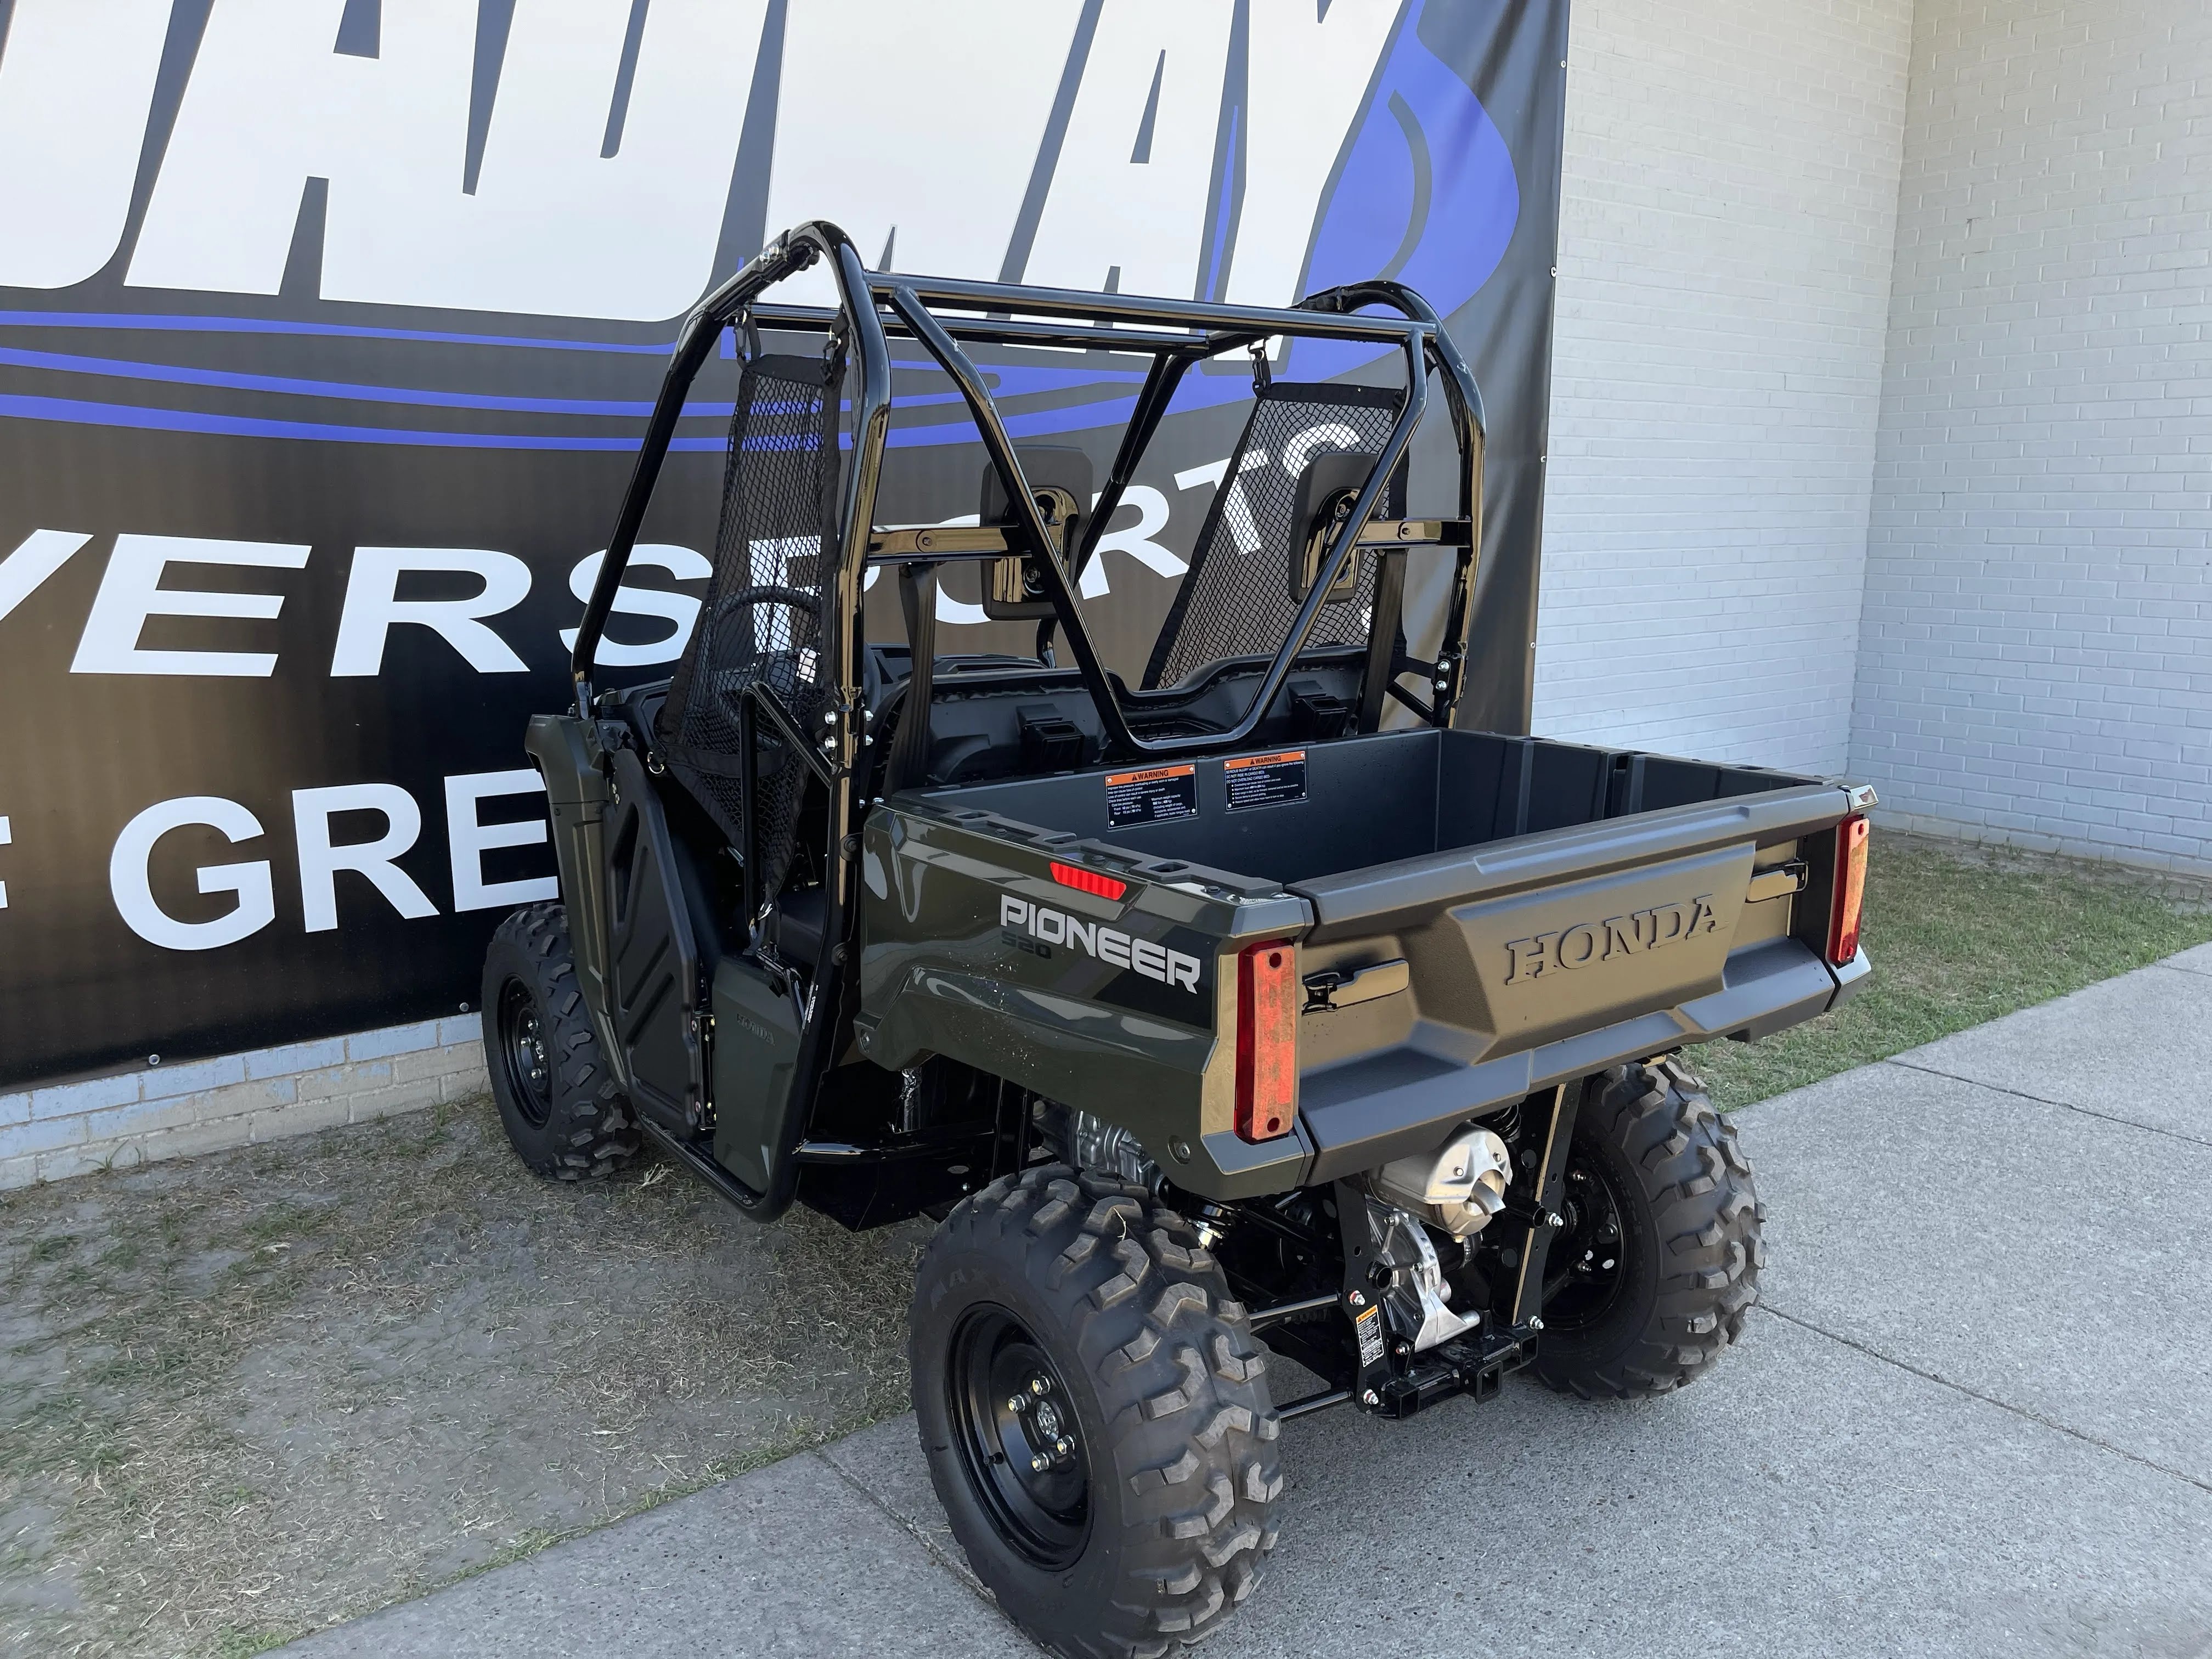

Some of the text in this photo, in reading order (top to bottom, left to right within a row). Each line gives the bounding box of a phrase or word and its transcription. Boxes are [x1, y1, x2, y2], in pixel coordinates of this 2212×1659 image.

[1138, 770, 1169, 780] WARNING
[1000, 928, 1052, 960] 520
[1000, 894, 1200, 995] PIONEER
[1505, 894, 1729, 986] HONDA
